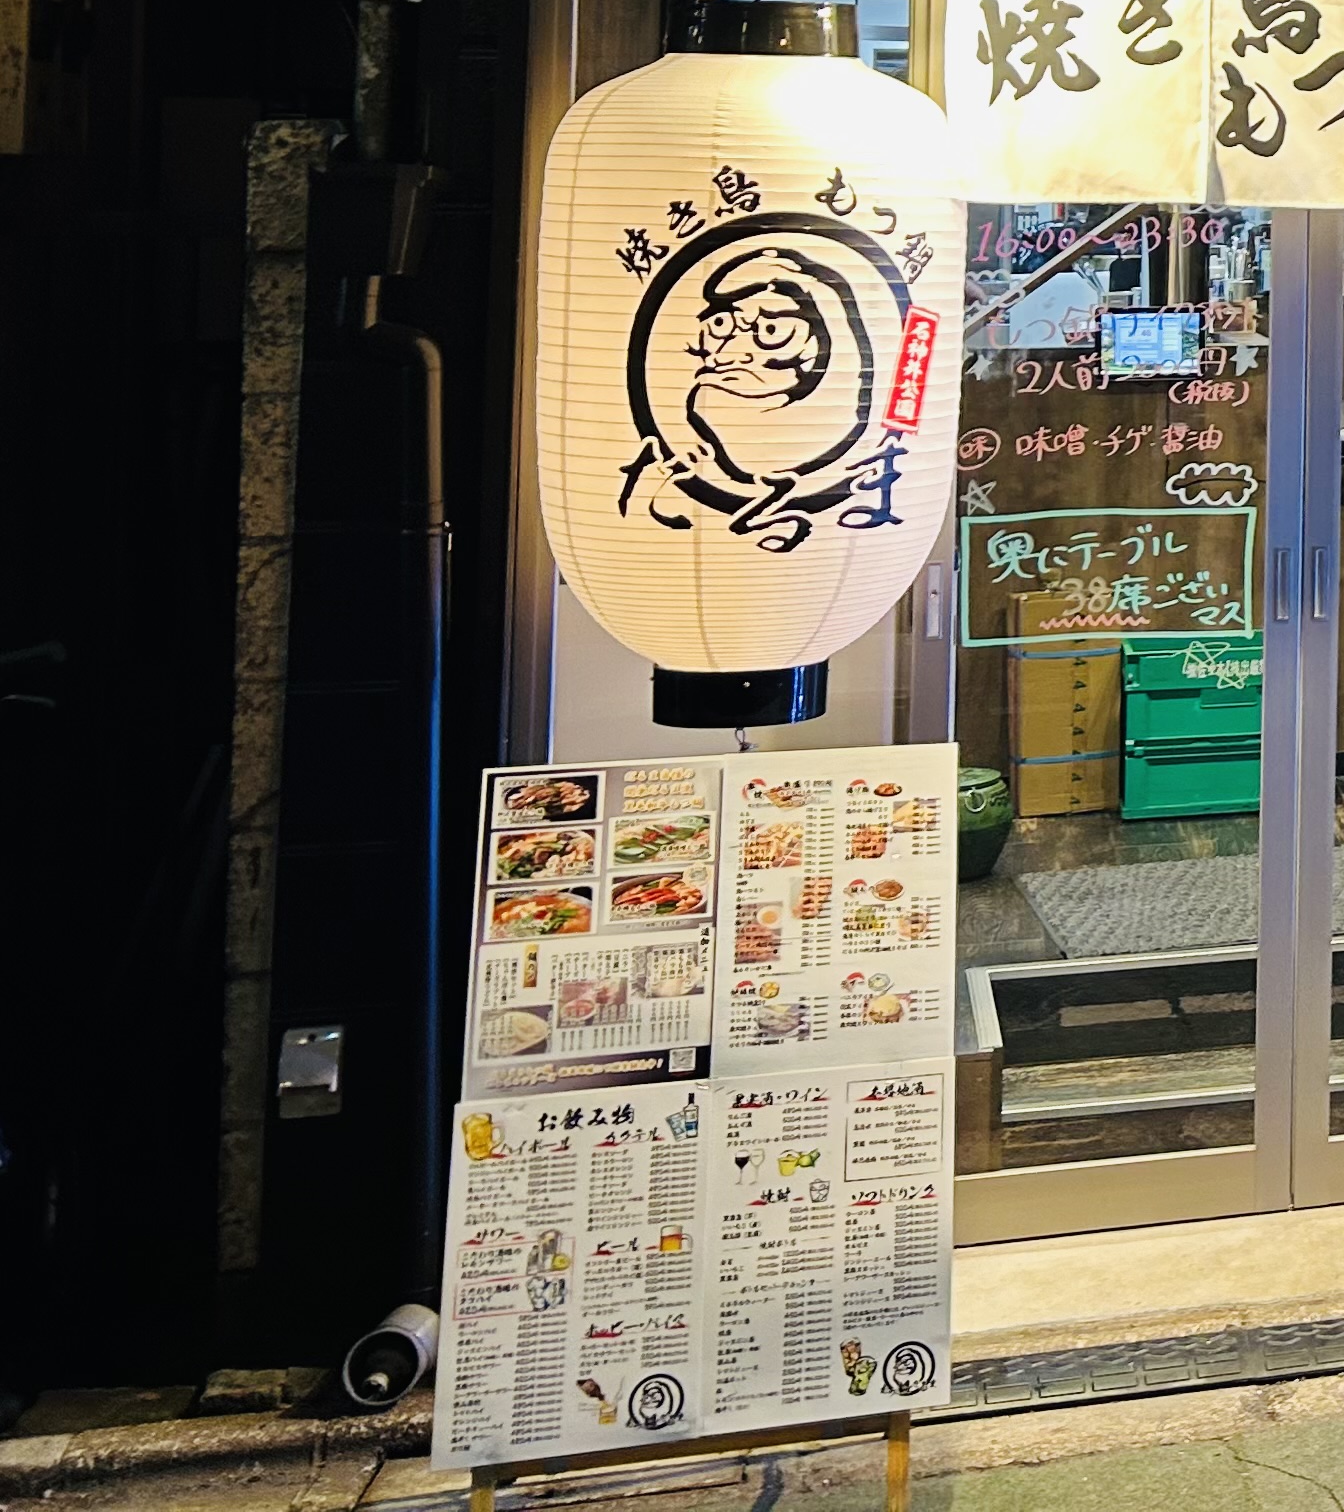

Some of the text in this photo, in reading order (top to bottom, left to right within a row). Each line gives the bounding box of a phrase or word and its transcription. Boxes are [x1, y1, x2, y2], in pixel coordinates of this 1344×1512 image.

[616, 164, 938, 285] 焼き鳥 もつ鍋
[617, 436, 909, 554] だるま
[987, 523, 1190, 586] 奥にテーブル
[1189, 601, 1246, 626] マス
[537, 1102, 637, 1133] お飲み物
